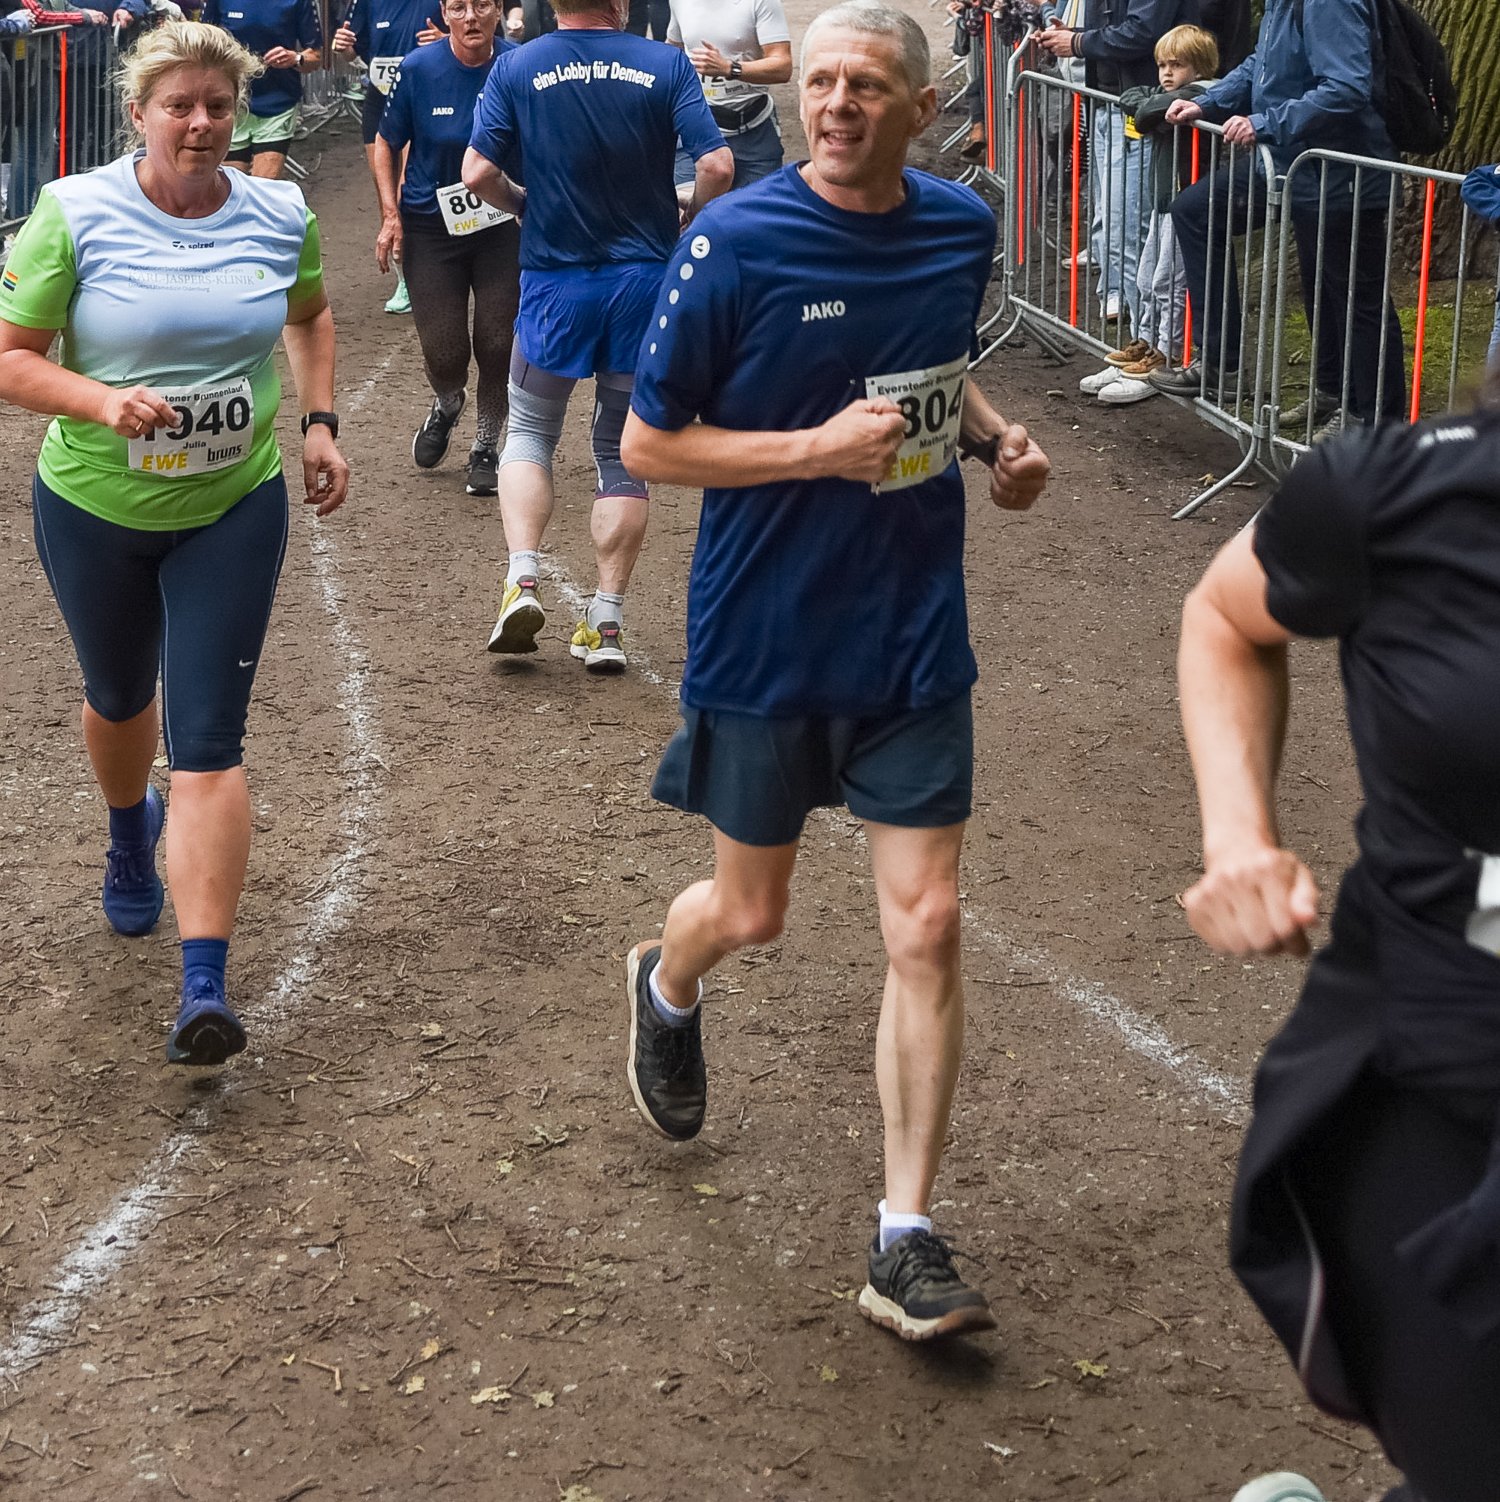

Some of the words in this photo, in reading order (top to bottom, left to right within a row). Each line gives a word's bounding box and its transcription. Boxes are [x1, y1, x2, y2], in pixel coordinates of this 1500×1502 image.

[533, 71, 558, 91] eine
[555, 64, 591, 84] Lobby
[593, 60, 610, 79] für
[610, 61, 656, 89] Demenz
[432, 107, 454, 116] JAKO
[449, 192, 483, 216] 80
[454, 218, 479, 233] EWE
[128, 272, 256, 286] KARL-JASPERS-KLINIK
[801, 300, 846, 322] JAKO
[194, 384, 244, 402] Brunnenlauf
[183, 441, 207, 450] Julia
[141, 452, 189, 471] EWE
[207, 444, 243, 463] bruns
